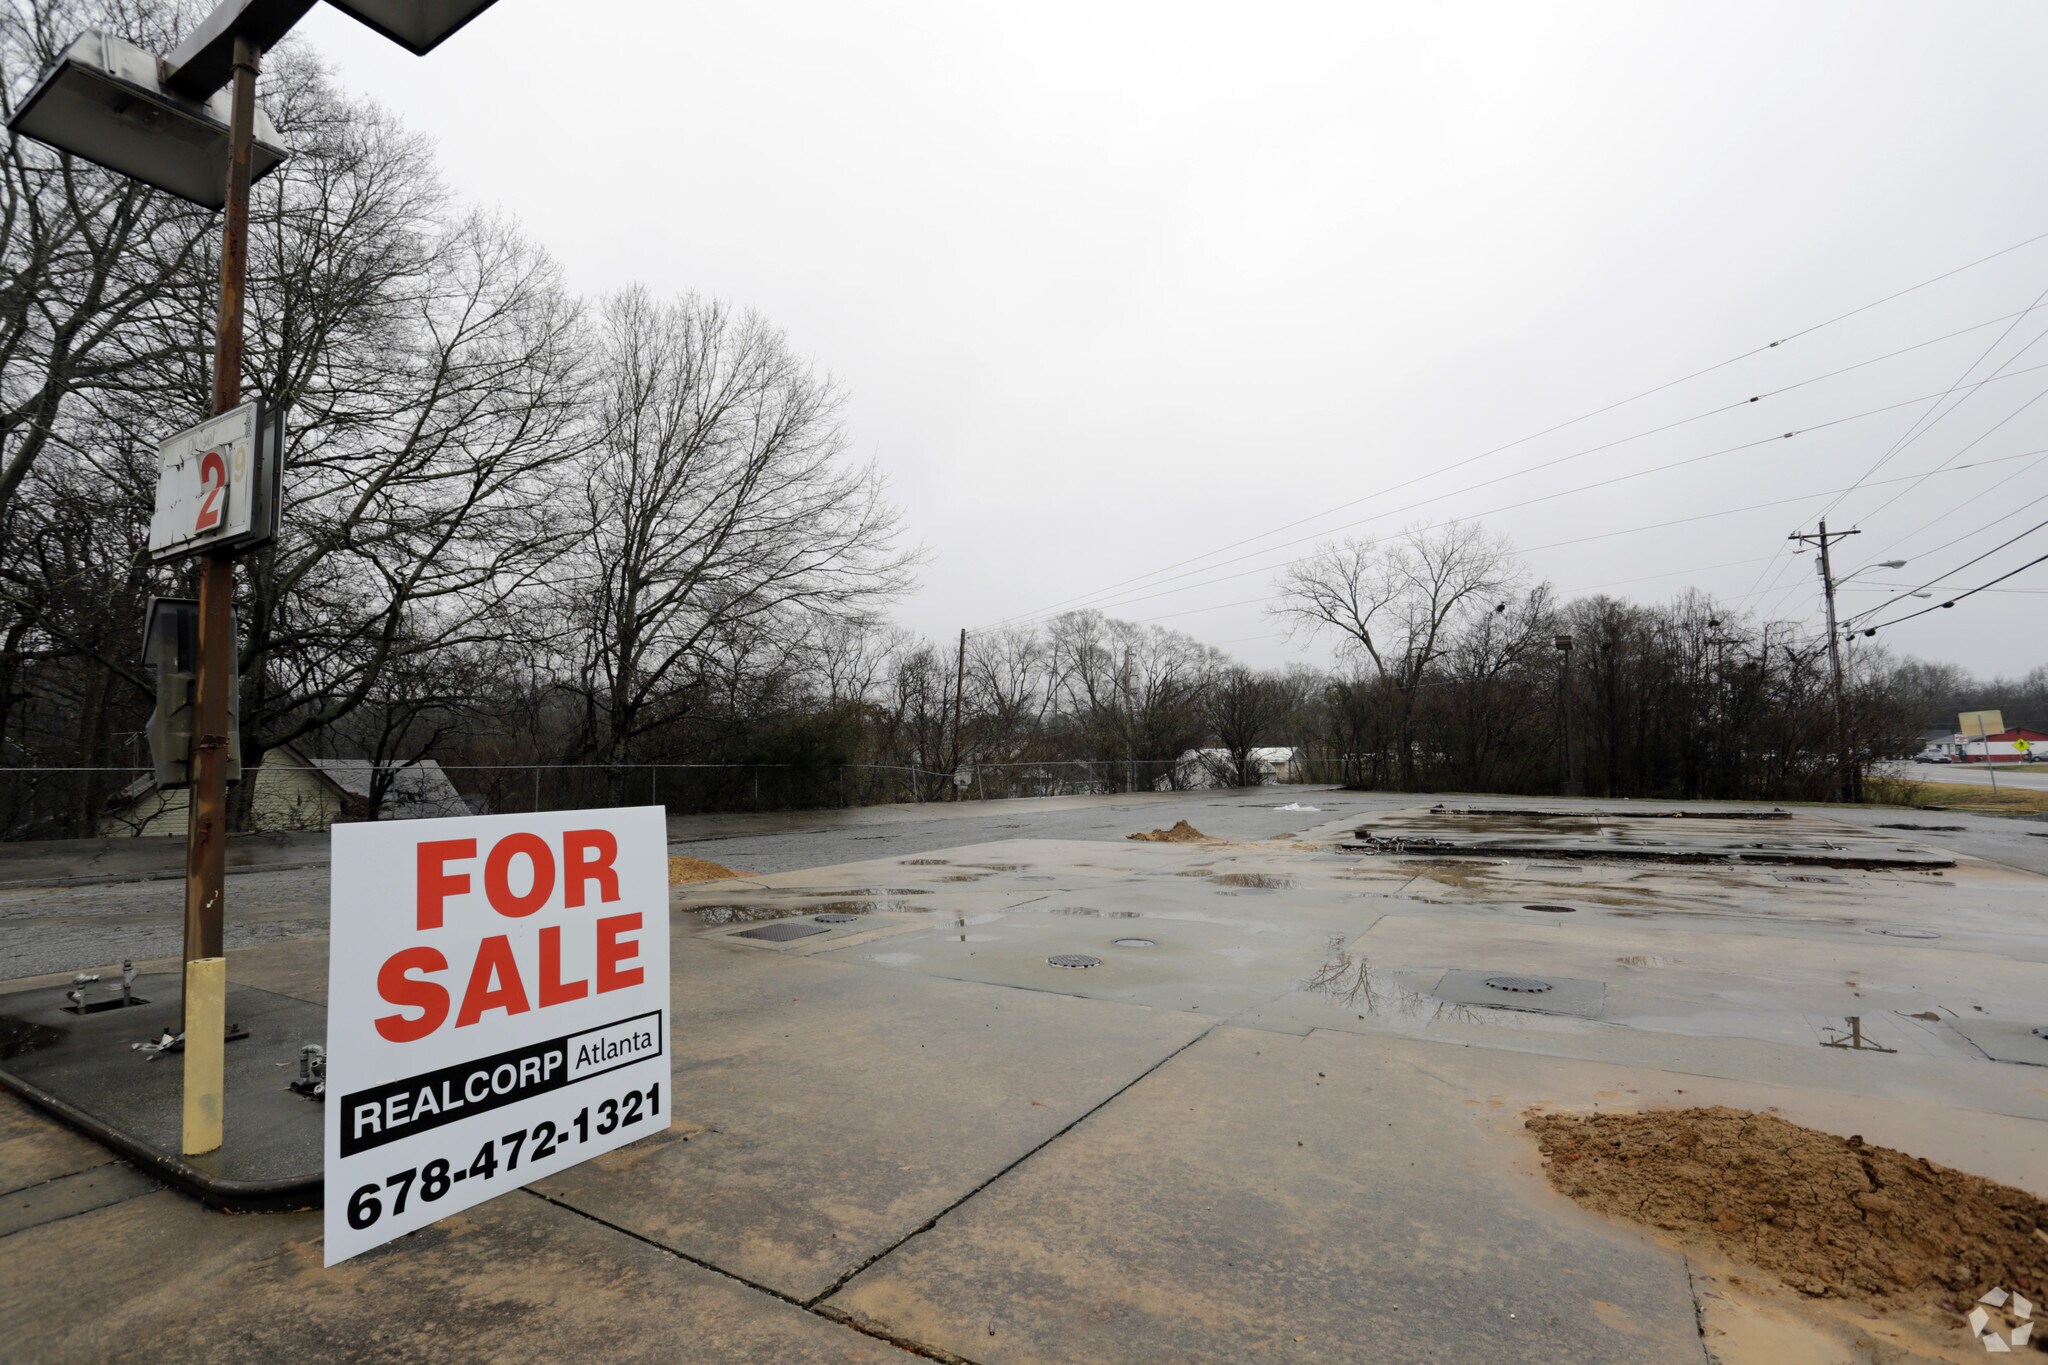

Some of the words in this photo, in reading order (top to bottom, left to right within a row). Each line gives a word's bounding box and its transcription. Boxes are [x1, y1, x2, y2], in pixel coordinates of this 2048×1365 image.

[195, 451, 226, 531] 2
[417, 829, 621, 931] FOR
[374, 912, 644, 1043] SALE
[353, 1050, 564, 1140] REALCORP
[575, 1028, 653, 1070] Atlanta
[346, 1082, 661, 1231] 678-472-1321
